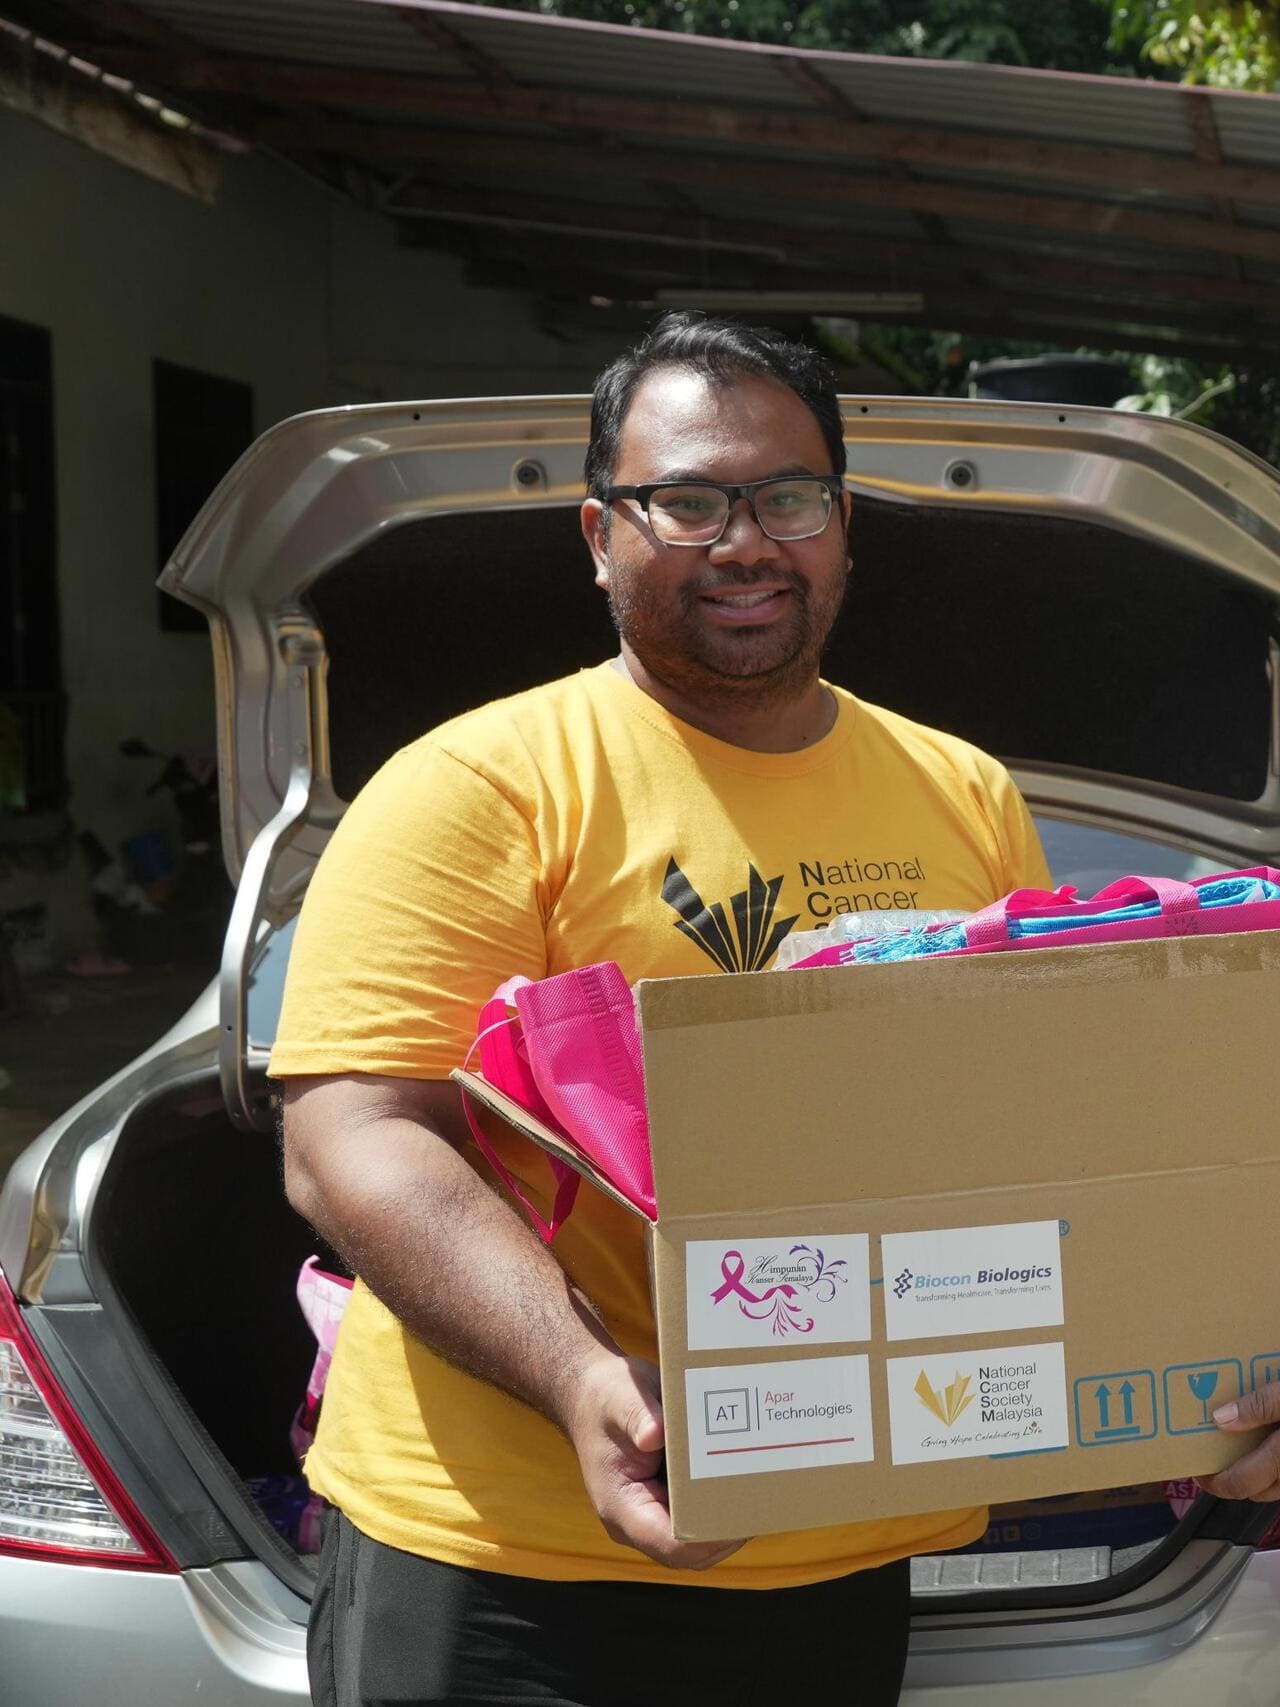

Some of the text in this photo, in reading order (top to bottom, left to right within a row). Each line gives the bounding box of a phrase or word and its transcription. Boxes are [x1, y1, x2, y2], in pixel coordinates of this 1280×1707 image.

[799, 857, 926, 887] National
[807, 890, 919, 917] Cancer
[914, 1265, 1053, 1289] Biocon Biologics
[979, 1362, 1037, 1380] National
[980, 1379, 1031, 1394] Cancer
[764, 1390, 795, 1406] Apar
[980, 1392, 1033, 1408] Society
[716, 1404, 739, 1421] AT
[765, 1403, 853, 1421] Technologies
[981, 1406, 1043, 1422] Malaysia
